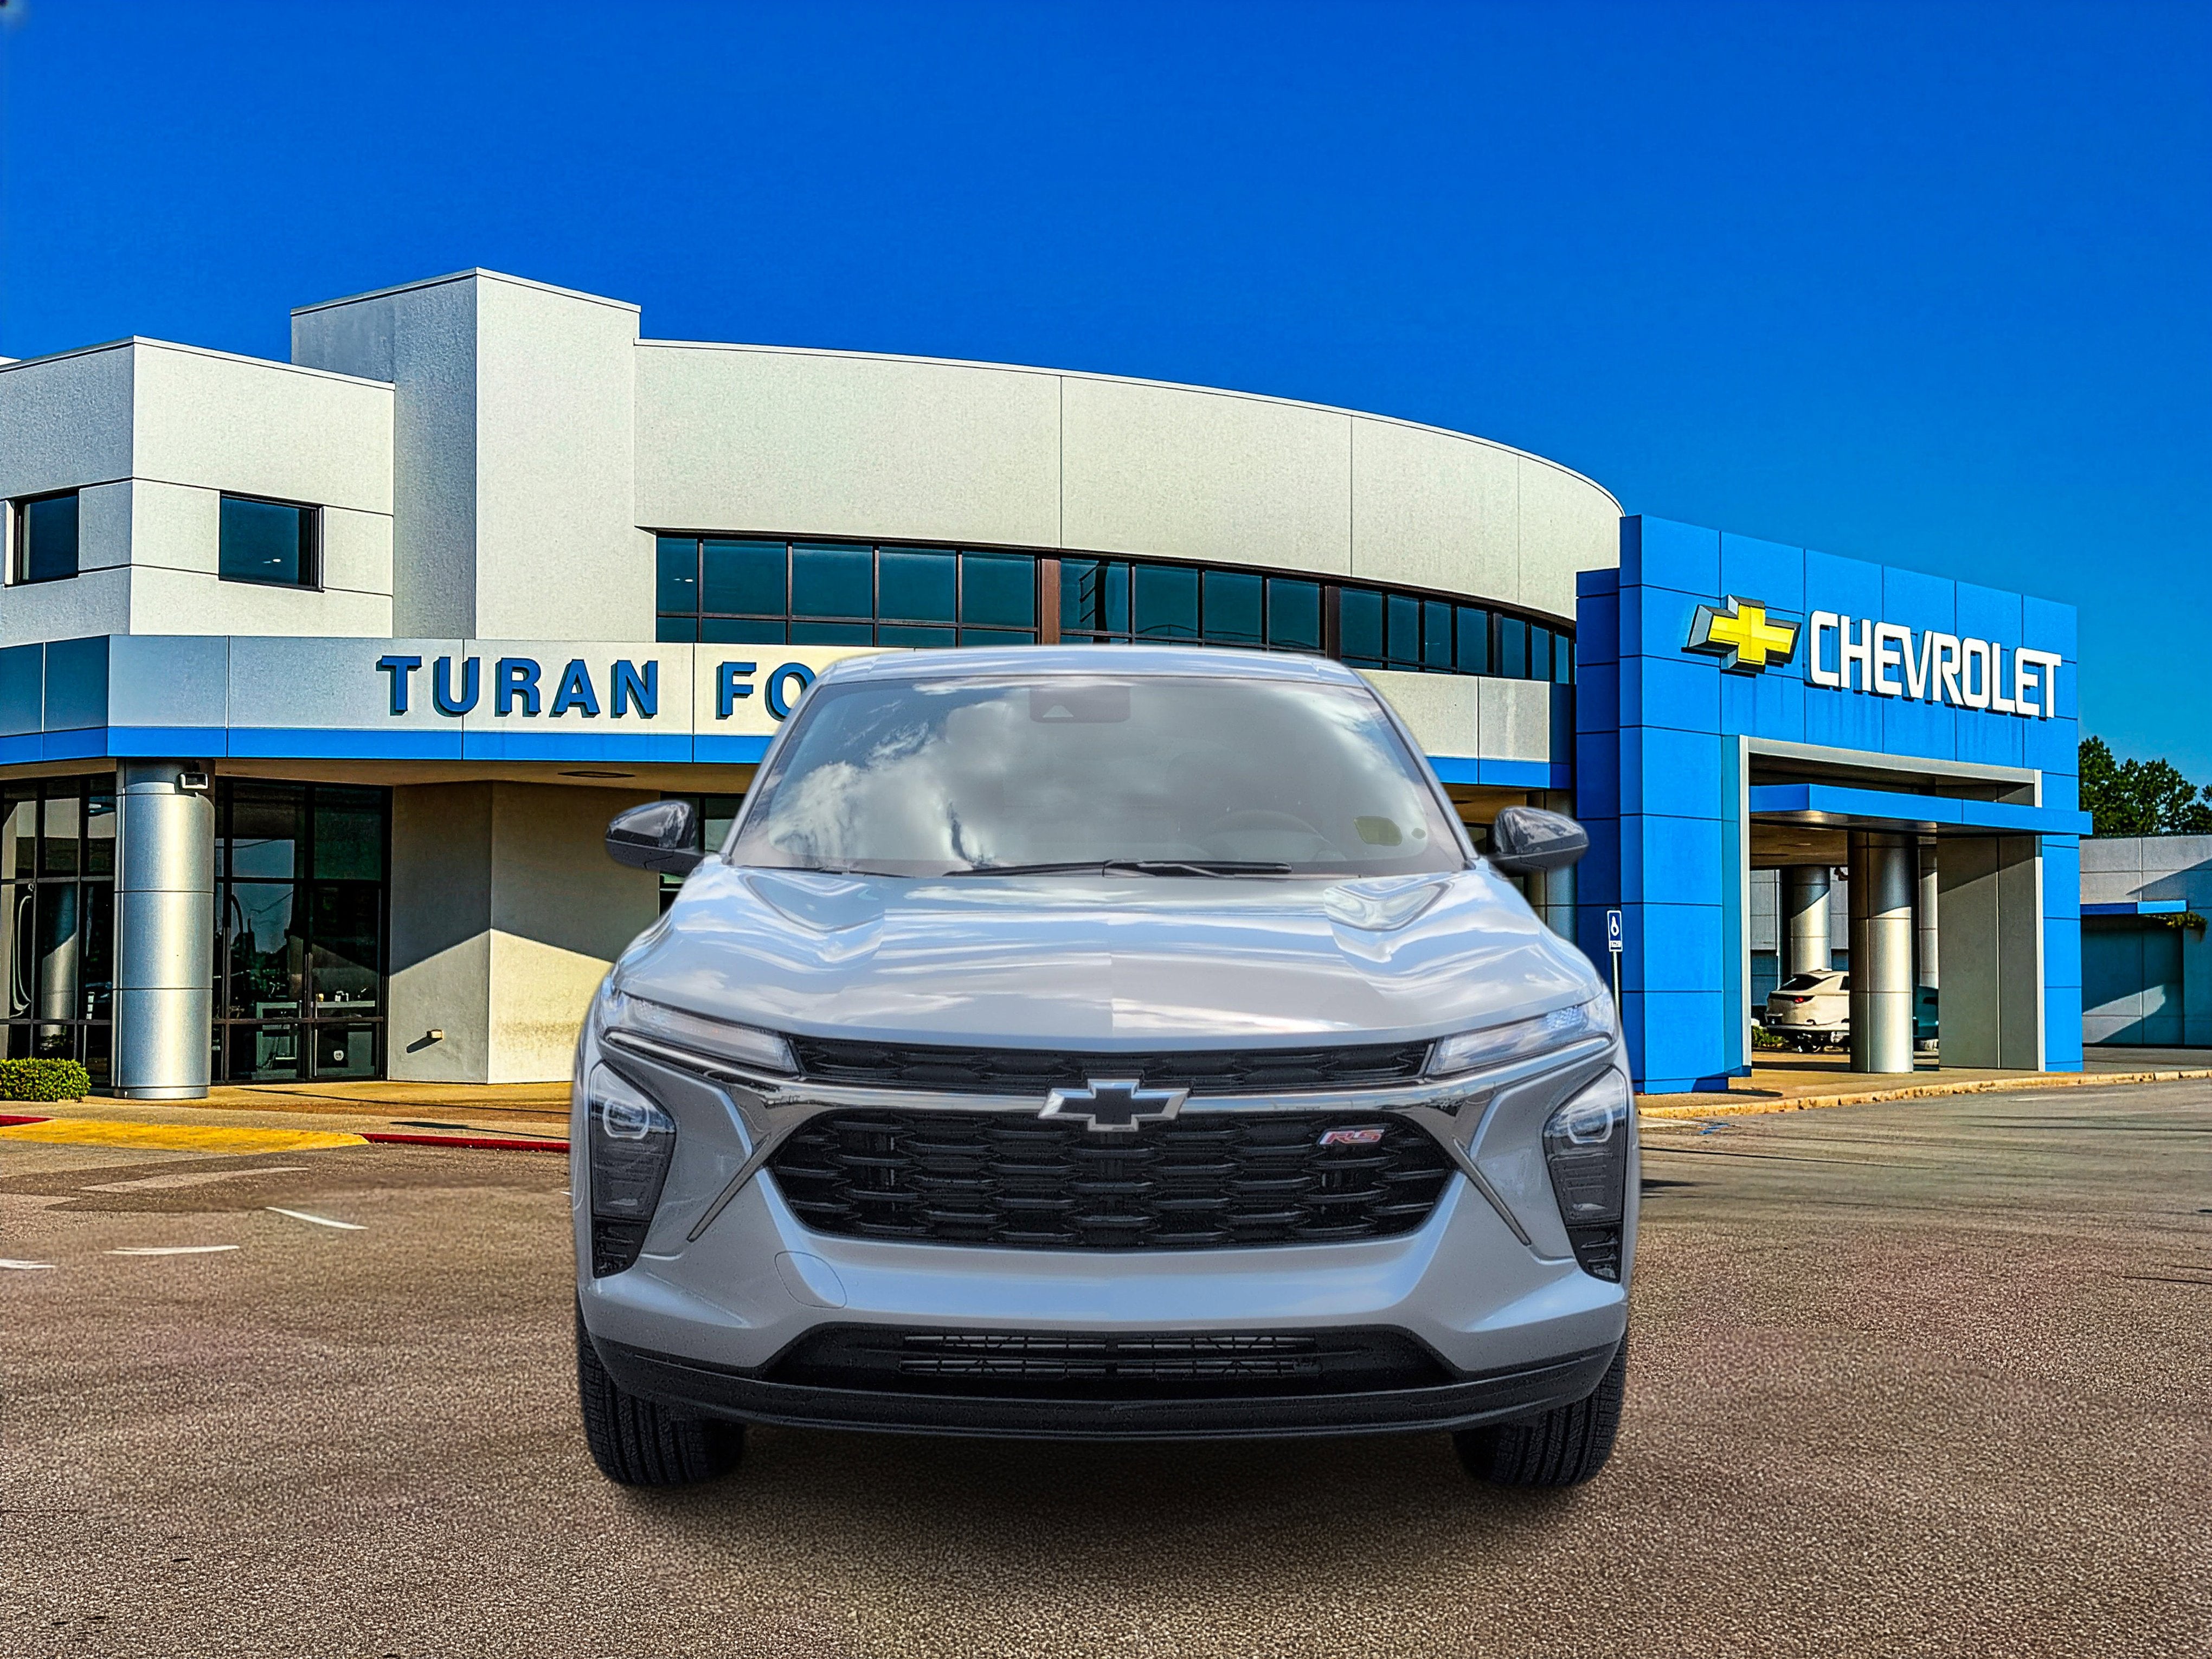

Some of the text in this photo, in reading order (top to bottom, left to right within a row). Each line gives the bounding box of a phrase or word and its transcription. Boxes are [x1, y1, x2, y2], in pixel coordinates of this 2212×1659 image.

[375, 654, 659, 719] TURAN
[1810, 610, 2062, 719] CHEVROLET
[1319, 1129, 1385, 1145] RS
